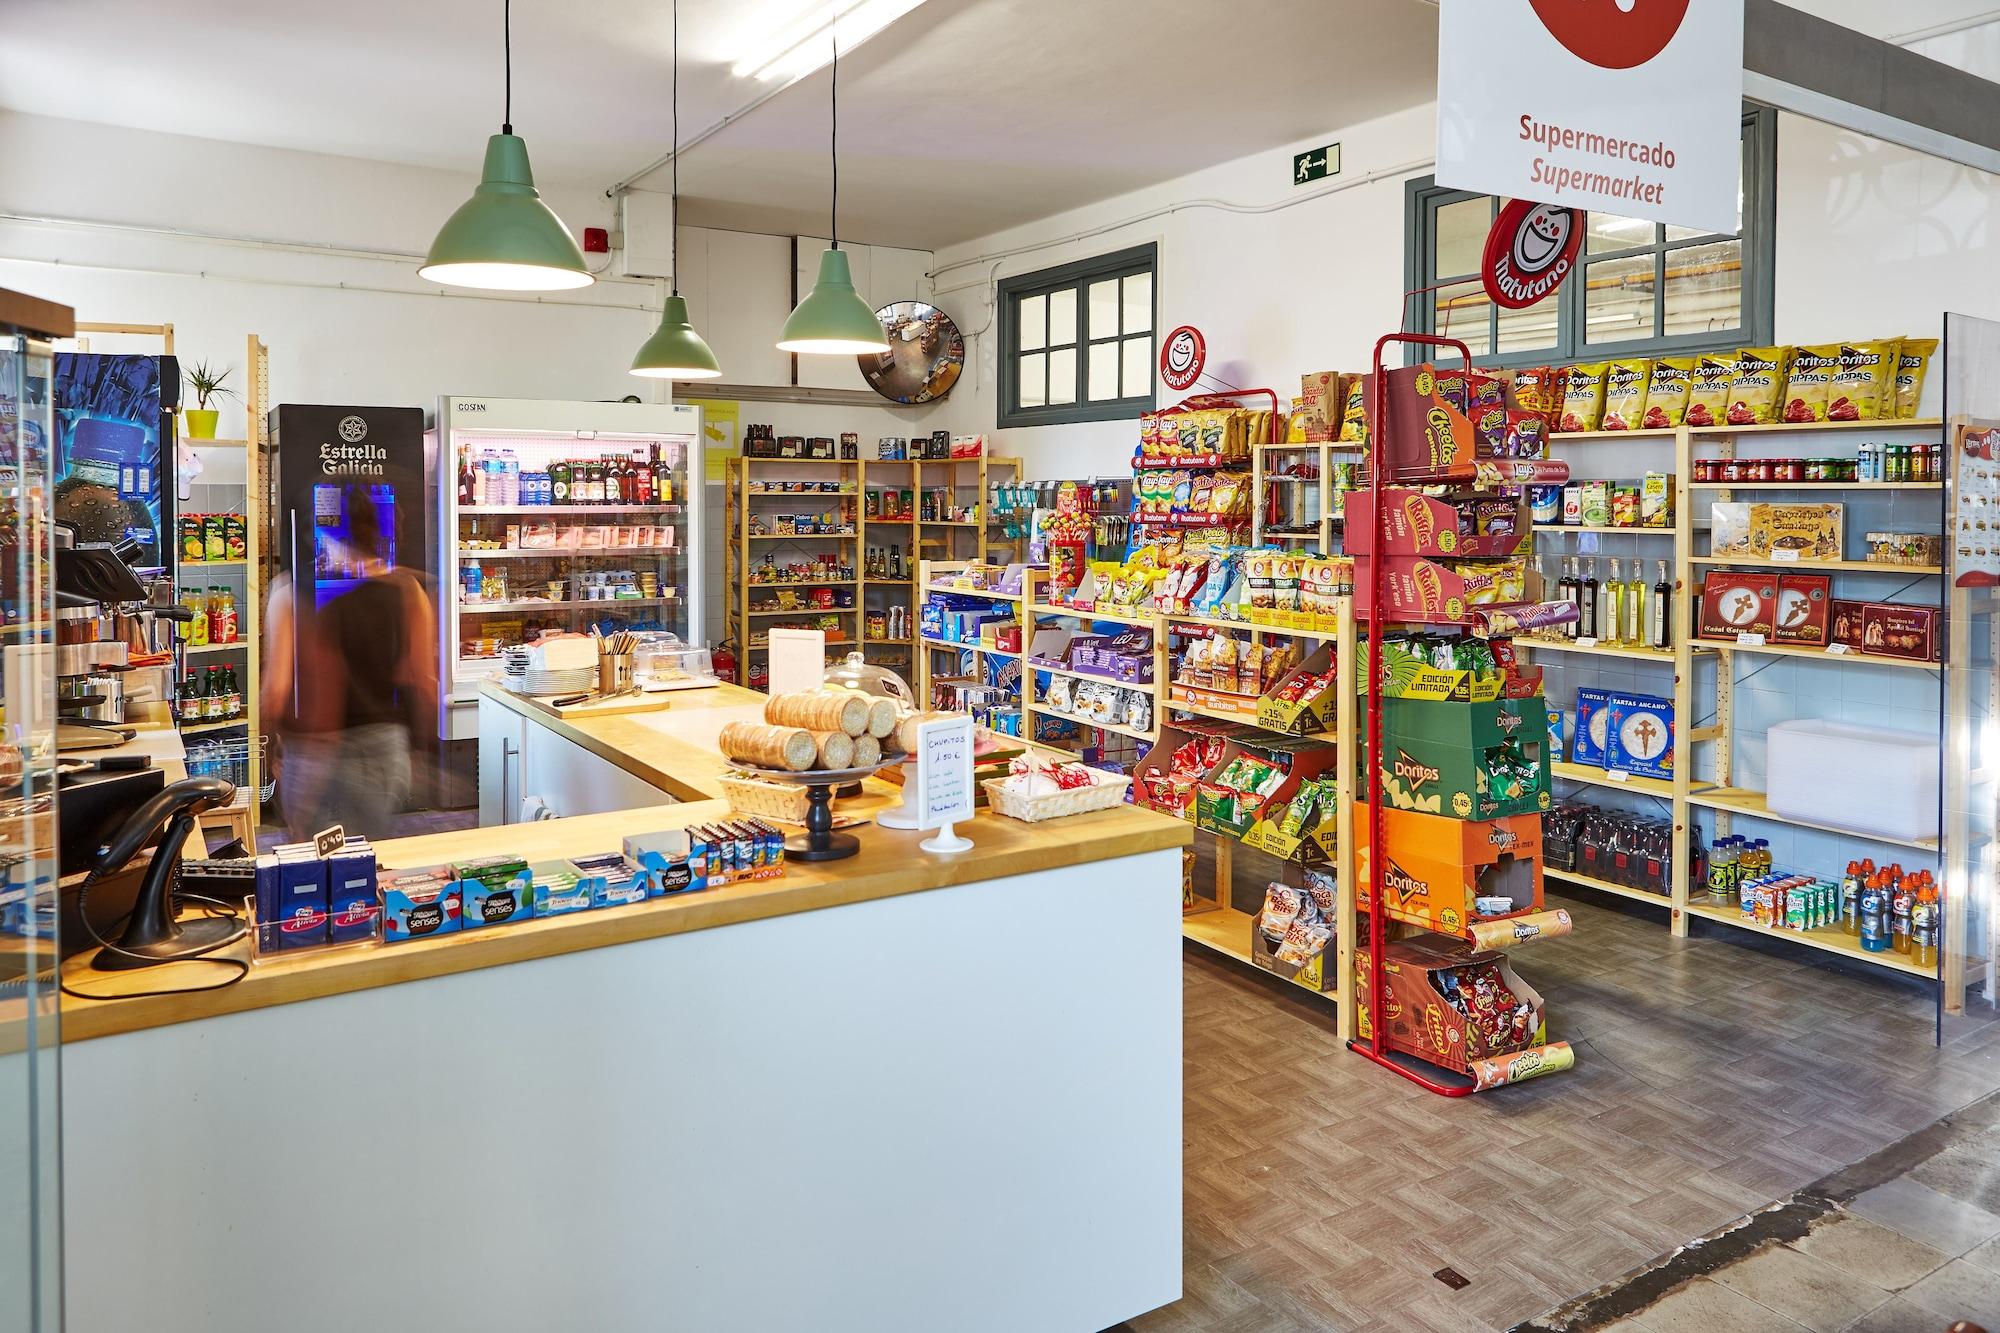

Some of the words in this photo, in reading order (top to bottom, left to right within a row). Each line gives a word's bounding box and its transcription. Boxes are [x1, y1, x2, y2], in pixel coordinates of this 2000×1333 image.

[1520, 114, 1676, 170] Supermercado
[1530, 157, 1664, 205] Supermarket
[1733, 361, 1777, 371] Doritos
[1608, 371, 1643, 383] Doritos
[1732, 377, 1770, 386] DIPPAS
[1692, 381, 1729, 390] DIPPAS
[1428, 407, 1458, 465] Cheetos
[319, 443, 387, 460] Estrella
[322, 459, 384, 475] Galicia
[1409, 497, 1432, 548] Ruffles
[1417, 563, 1440, 612] Ruffles
[1464, 575, 1493, 590] Ruffles
[1111, 633, 1134, 645] LEO
[1421, 673, 1454, 684] EDICIÓN
[1411, 683, 1450, 693] LIMITADA
[1612, 699, 1637, 707] TARTAS
[1638, 702, 1666, 710] ANCANO
[1259, 717, 1287, 730] GRATIS
[1496, 715, 1522, 727] Doritos
[1394, 762, 1440, 781] Doritos
[1265, 833, 1286, 846] EDICIÓN
[1488, 832, 1517, 845] Doritos
[1263, 842, 1288, 857] LIMITADA
[664, 876, 690, 886] senses
[737, 872, 753, 880] BIC
[1384, 871, 1429, 896] Doritos
[485, 904, 513, 916] senses
[410, 916, 440, 928] senses
[1514, 926, 1540, 938] Doritos
[1508, 1051, 1540, 1080] Cheetos
